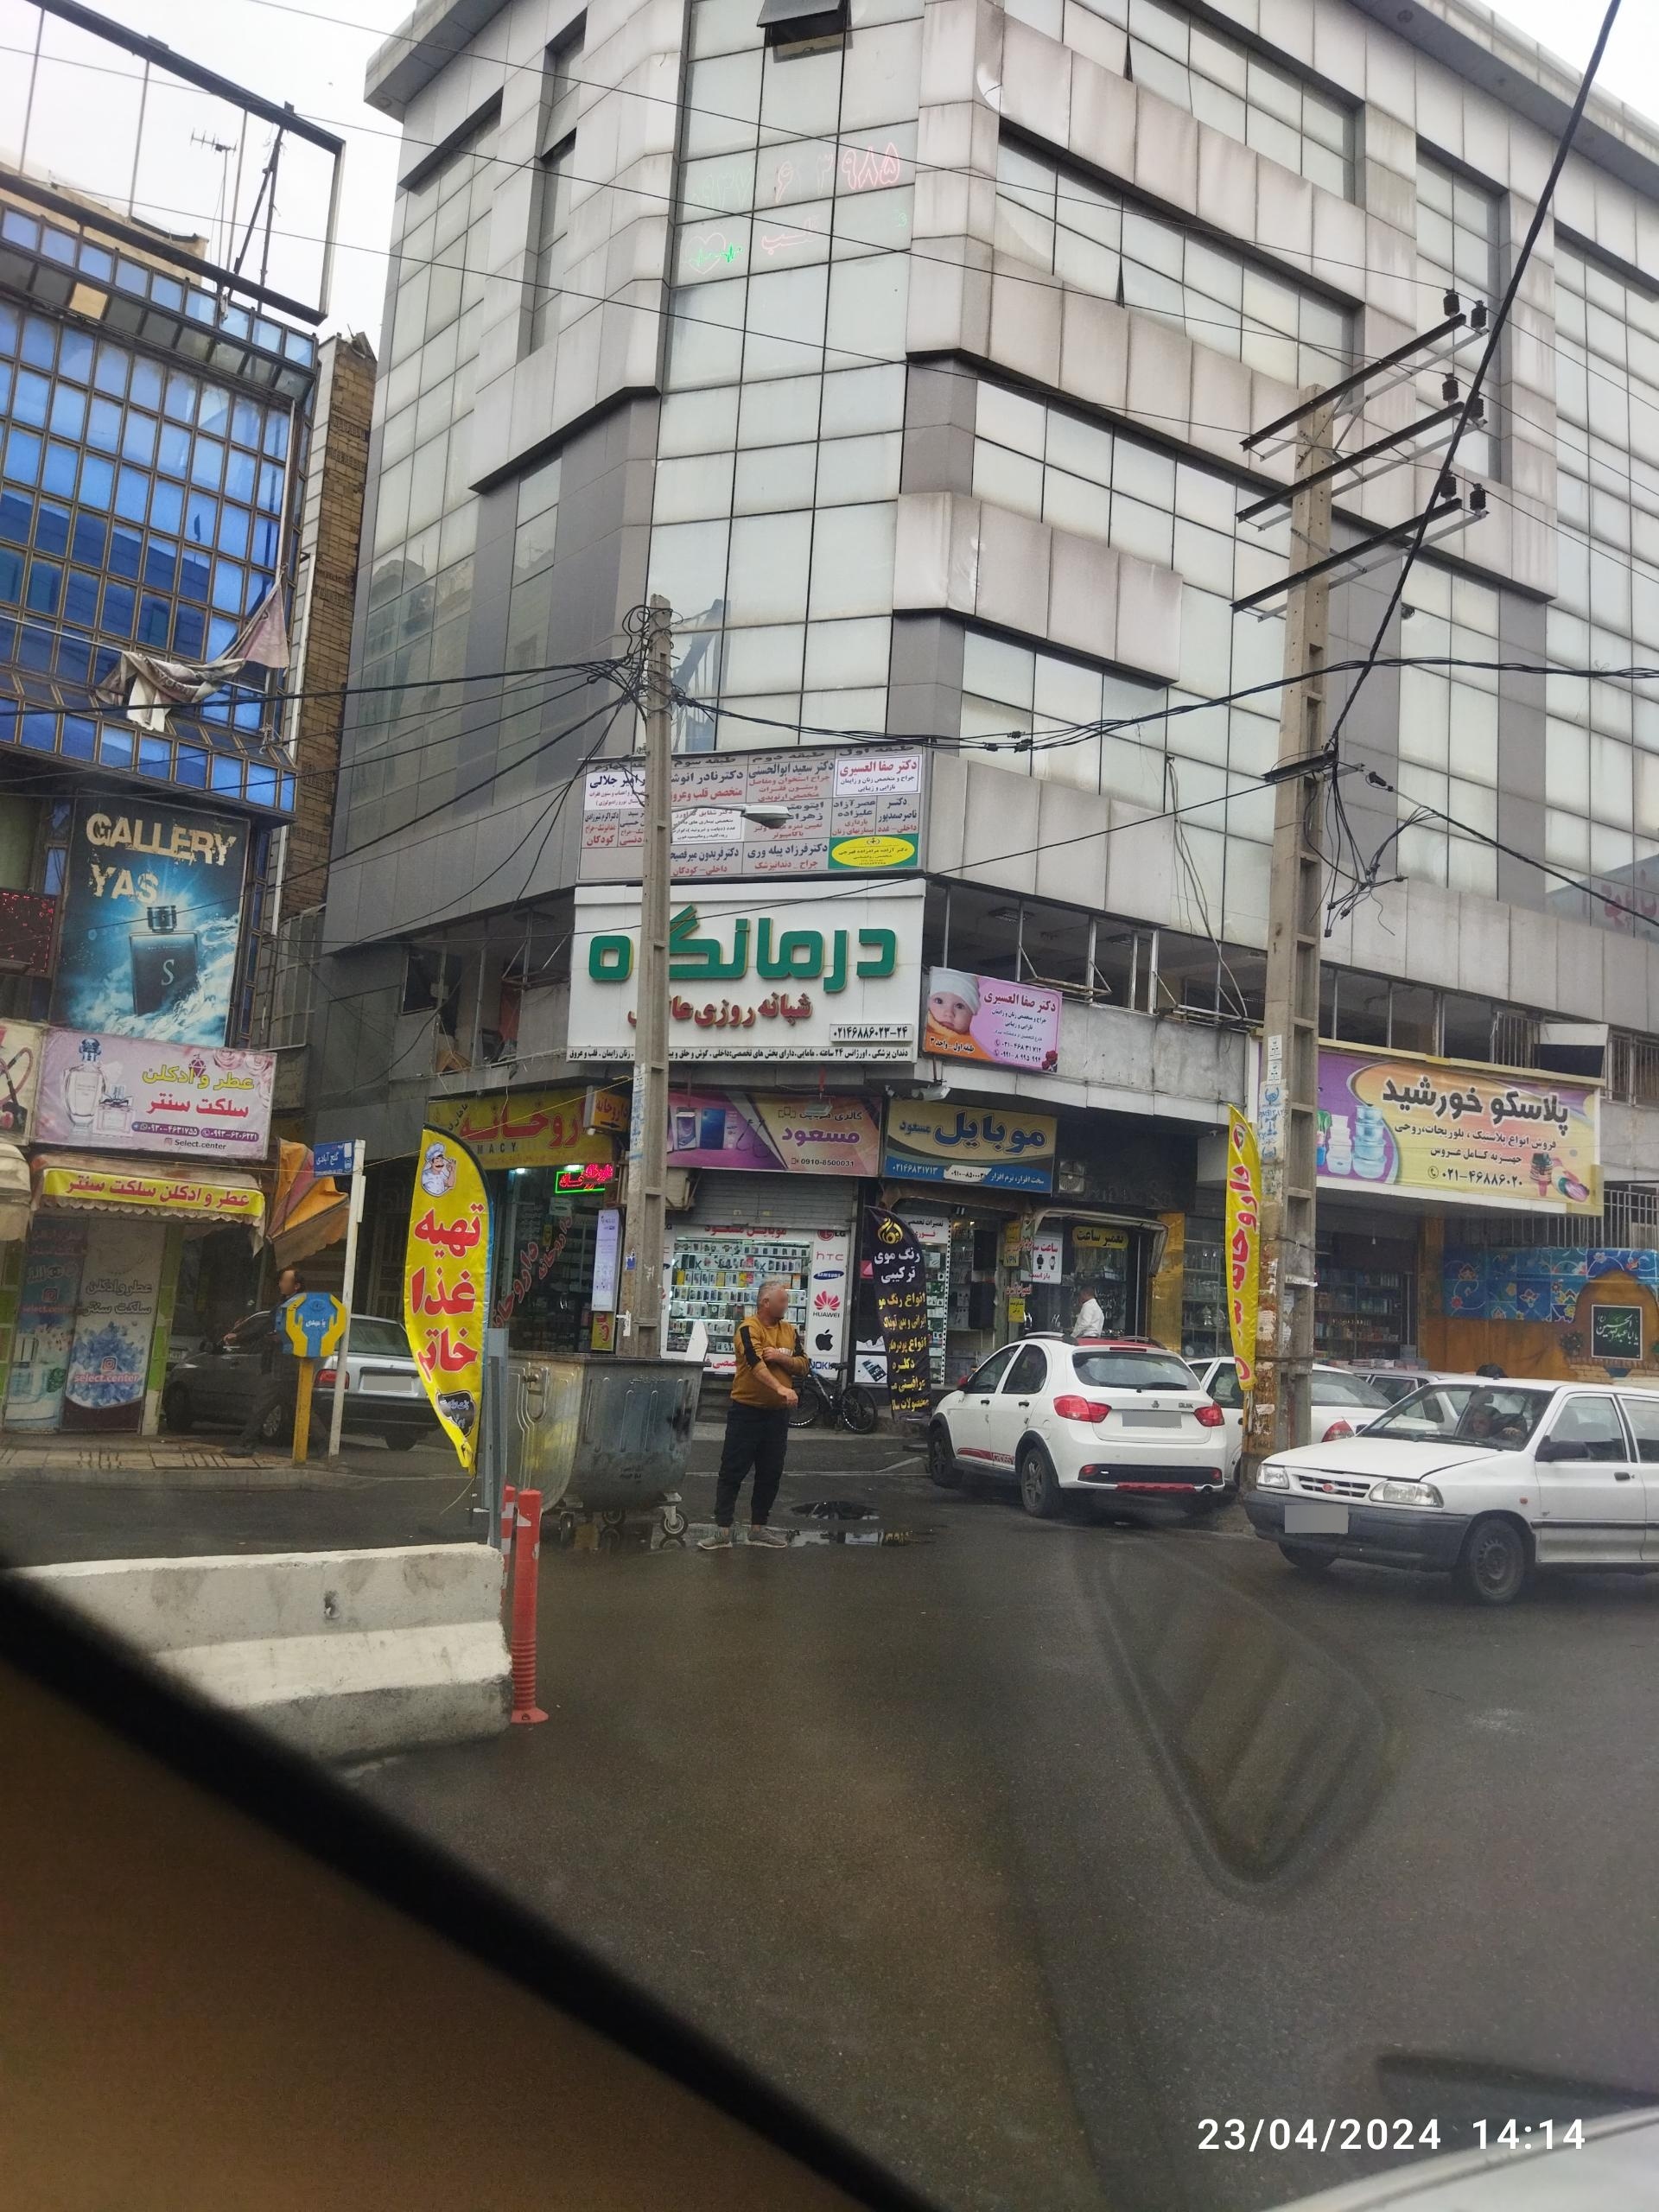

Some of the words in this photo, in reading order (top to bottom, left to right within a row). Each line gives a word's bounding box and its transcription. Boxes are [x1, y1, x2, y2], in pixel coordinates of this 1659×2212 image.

[749, 763, 790, 779] ابوالحسنی
[793, 764, 812, 774] سعید
[815, 760, 834, 774] دکتر
[840, 760, 876, 777] العسیری
[879, 760, 893, 771] صفا
[897, 760, 917, 774] دکتر
[589, 774, 617, 788] جلالی
[696, 771, 718, 785] نادر
[719, 770, 743, 783] دکتر
[693, 788, 709, 800] قلب
[710, 787, 742, 800] متخصص
[887, 798, 907, 809] دکتر
[86, 813, 237, 866] GALLERY
[587, 836, 614, 846] کودکان
[723, 847, 739, 861] دکتر
[785, 843, 808, 856] فرزاد
[809, 843, 828, 856] دکتر
[799, 859, 817, 869] جراح
[89, 863, 159, 904] YAS
[588, 904, 897, 993] درمانگه
[984, 992, 1020, 1004] العسیری
[1021, 995, 1035, 1007] صفا
[694, 999, 756, 1027] روزی
[758, 991, 813, 1027] شبانه
[1037, 1001, 1056, 1013] دکتر
[569, 1049, 582, 1059] عروق
[588, 1049, 597, 1058] قلب
[601, 1049, 619, 1058] زایمان
[753, 1049, 763, 1058] های
[765, 1049, 778, 1058] بخش
[835, 1048, 843, 1057] ۲۴
[844, 1049, 868, 1059] اورژانس
[872, 1049, 891, 1059] پزشکی
[892, 1049, 908, 1058] دندان
[143, 1065, 194, 1084] ادکلن
[197, 1073, 210, 1089] و
[213, 1071, 254, 1090] عطر
[146, 1092, 190, 1115] سنتر
[1382, 1076, 1483, 1120] خورشید
[196, 1097, 249, 1118] سلکت
[1491, 1090, 1568, 1136] پلاسکو
[899, 1121, 931, 1135] مسعود
[934, 1109, 1046, 1155] موبایل
[781, 1127, 860, 1147] مسعود
[1472, 1130, 1506, 1147] پلاستیک
[1508, 1137, 1529, 1148] انواع
[1531, 1139, 1556, 1151] فروش
[1431, 1147, 1461, 1159] عروس
[1464, 1148, 1487, 1160] کامل
[67, 1175, 105, 1193] سنتر
[109, 1180, 156, 1198] سلکت
[159, 1185, 201, 1202] ادکلن
[205, 1193, 212, 1207] و
[217, 1191, 249, 1209] عطر
[415, 1203, 482, 1258] تهیه
[1077, 1230, 1101, 1241] ساعت
[874, 1252, 896, 1264] موی
[899, 1247, 920, 1262] رنگ
[881, 1266, 916, 1284] ترکیبی
[411, 1267, 475, 1316] غذا
[887, 1293, 903, 1307] رنگ
[905, 1292, 925, 1307] انواع
[909, 1336, 926, 1352] انواع
